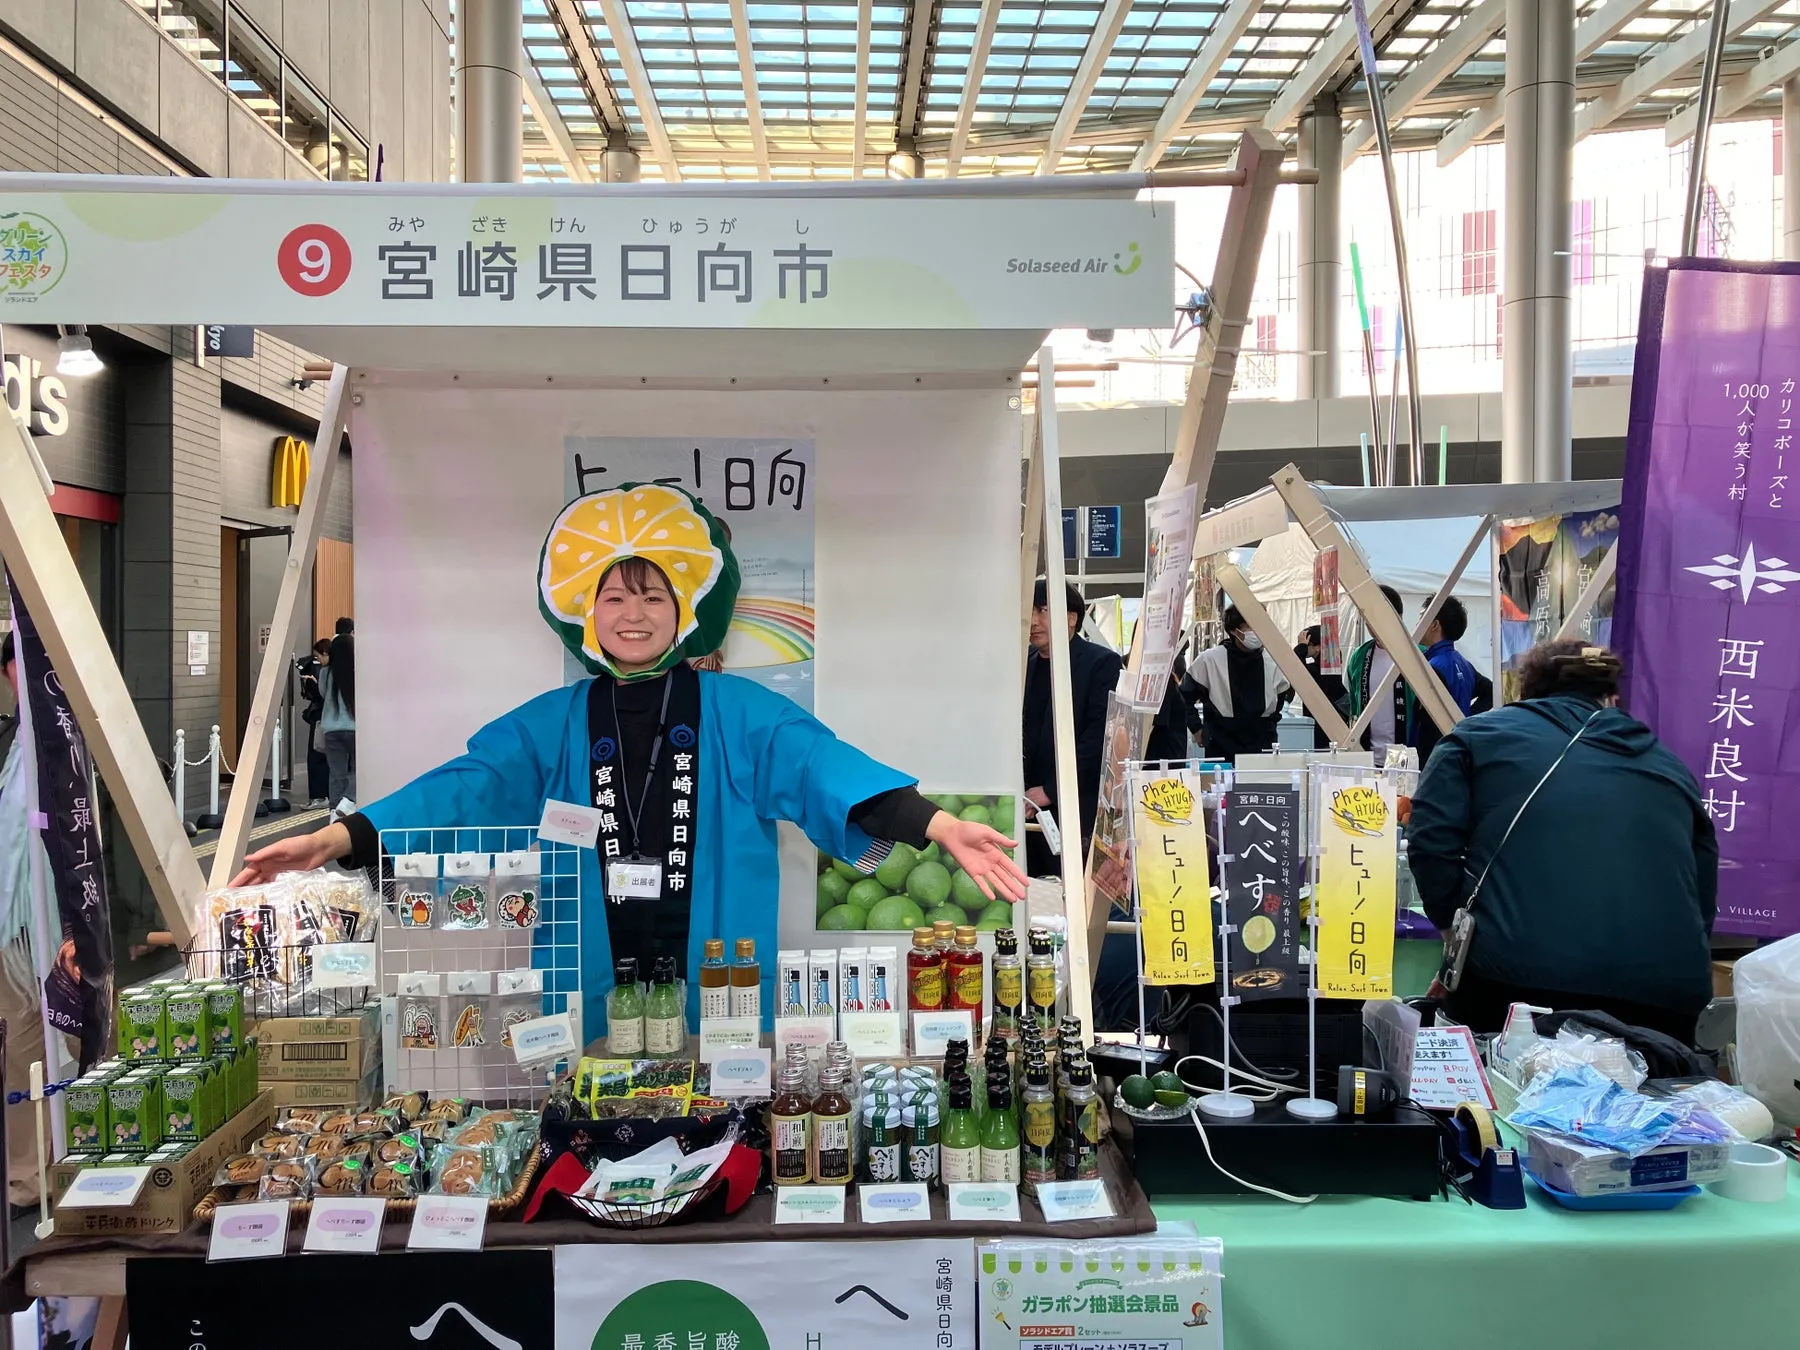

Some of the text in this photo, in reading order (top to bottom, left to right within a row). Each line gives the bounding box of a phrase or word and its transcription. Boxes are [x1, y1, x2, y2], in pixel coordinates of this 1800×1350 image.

[388, 217, 809, 235] みや ざき けん ひゅうが し
[2, 247, 46, 261] スカイ
[297, 239, 332, 283] 9
[0, 264, 52, 279] フェスタ
[378, 241, 833, 304] 宮崎県日向市
[1006, 257, 1109, 274] Solaseed Air
[1769, 377, 1796, 508] カリコボーズと
[1701, 637, 1765, 833] 西米良村
[1142, 772, 1186, 801] Phew!
[1332, 781, 1380, 808] Phew!
[1163, 790, 1196, 808] HYUGA
[1355, 800, 1390, 816] HYUGA
[667, 752, 694, 892] 宮崎県日向市
[1238, 810, 1278, 912] へべす
[631, 877, 656, 887] 出展者
[1729, 905, 1777, 918] VILLAGE
[1193, 969, 1210, 977] Town
[1370, 983, 1388, 993] Town
[834, 1284, 910, 1322] へ
[935, 1257, 953, 1349] 宮崎県日向
[1022, 1294, 1180, 1314] ガラポン抽選会景品
[620, 1329, 742, 1350] 最香旨酸
[1022, 1327, 1073, 1336] ソラシドエア賞
[1078, 1326, 1101, 1336] 2セット
